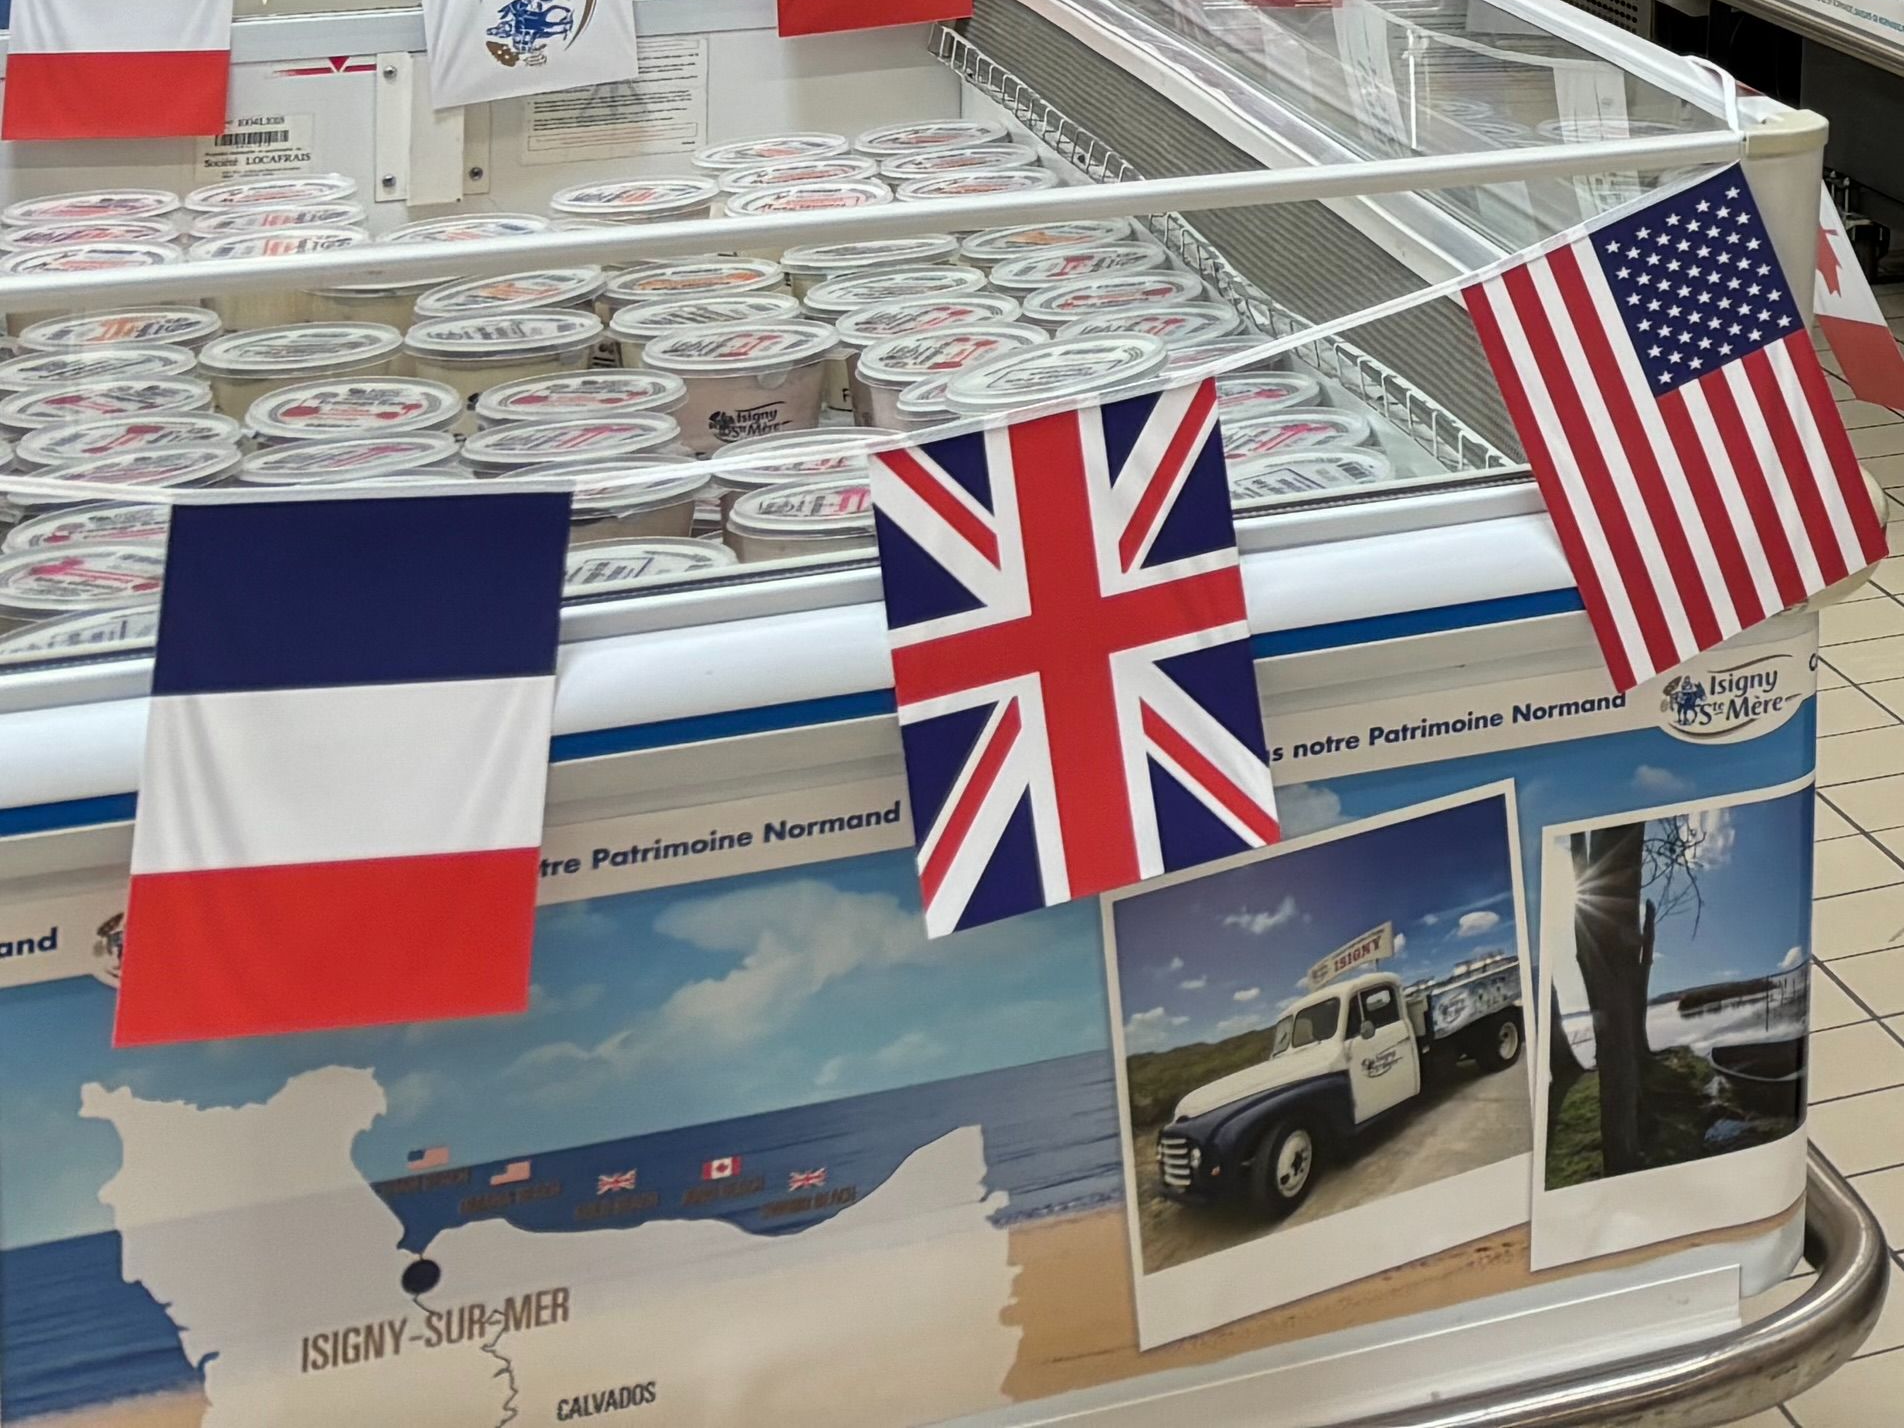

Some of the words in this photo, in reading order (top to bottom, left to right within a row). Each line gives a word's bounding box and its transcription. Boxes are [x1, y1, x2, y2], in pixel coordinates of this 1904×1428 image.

[245, 152, 312, 166] LOCAFRAIS
[736, 409, 779, 424] Isigny
[1708, 666, 1779, 698] Isigny
[1292, 734, 1361, 761] notre
[1368, 707, 1505, 748] Patrimoine
[1512, 690, 1628, 724] Normand
[1726, 694, 1784, 721] Mère
[591, 826, 753, 871] Patrimoine
[763, 800, 902, 844] Normand
[1333, 934, 1382, 973] ISIGNY
[300, 1286, 572, 1376] ISIGNY-SUR-MER
[556, 1380, 657, 1423] CALVADOS
